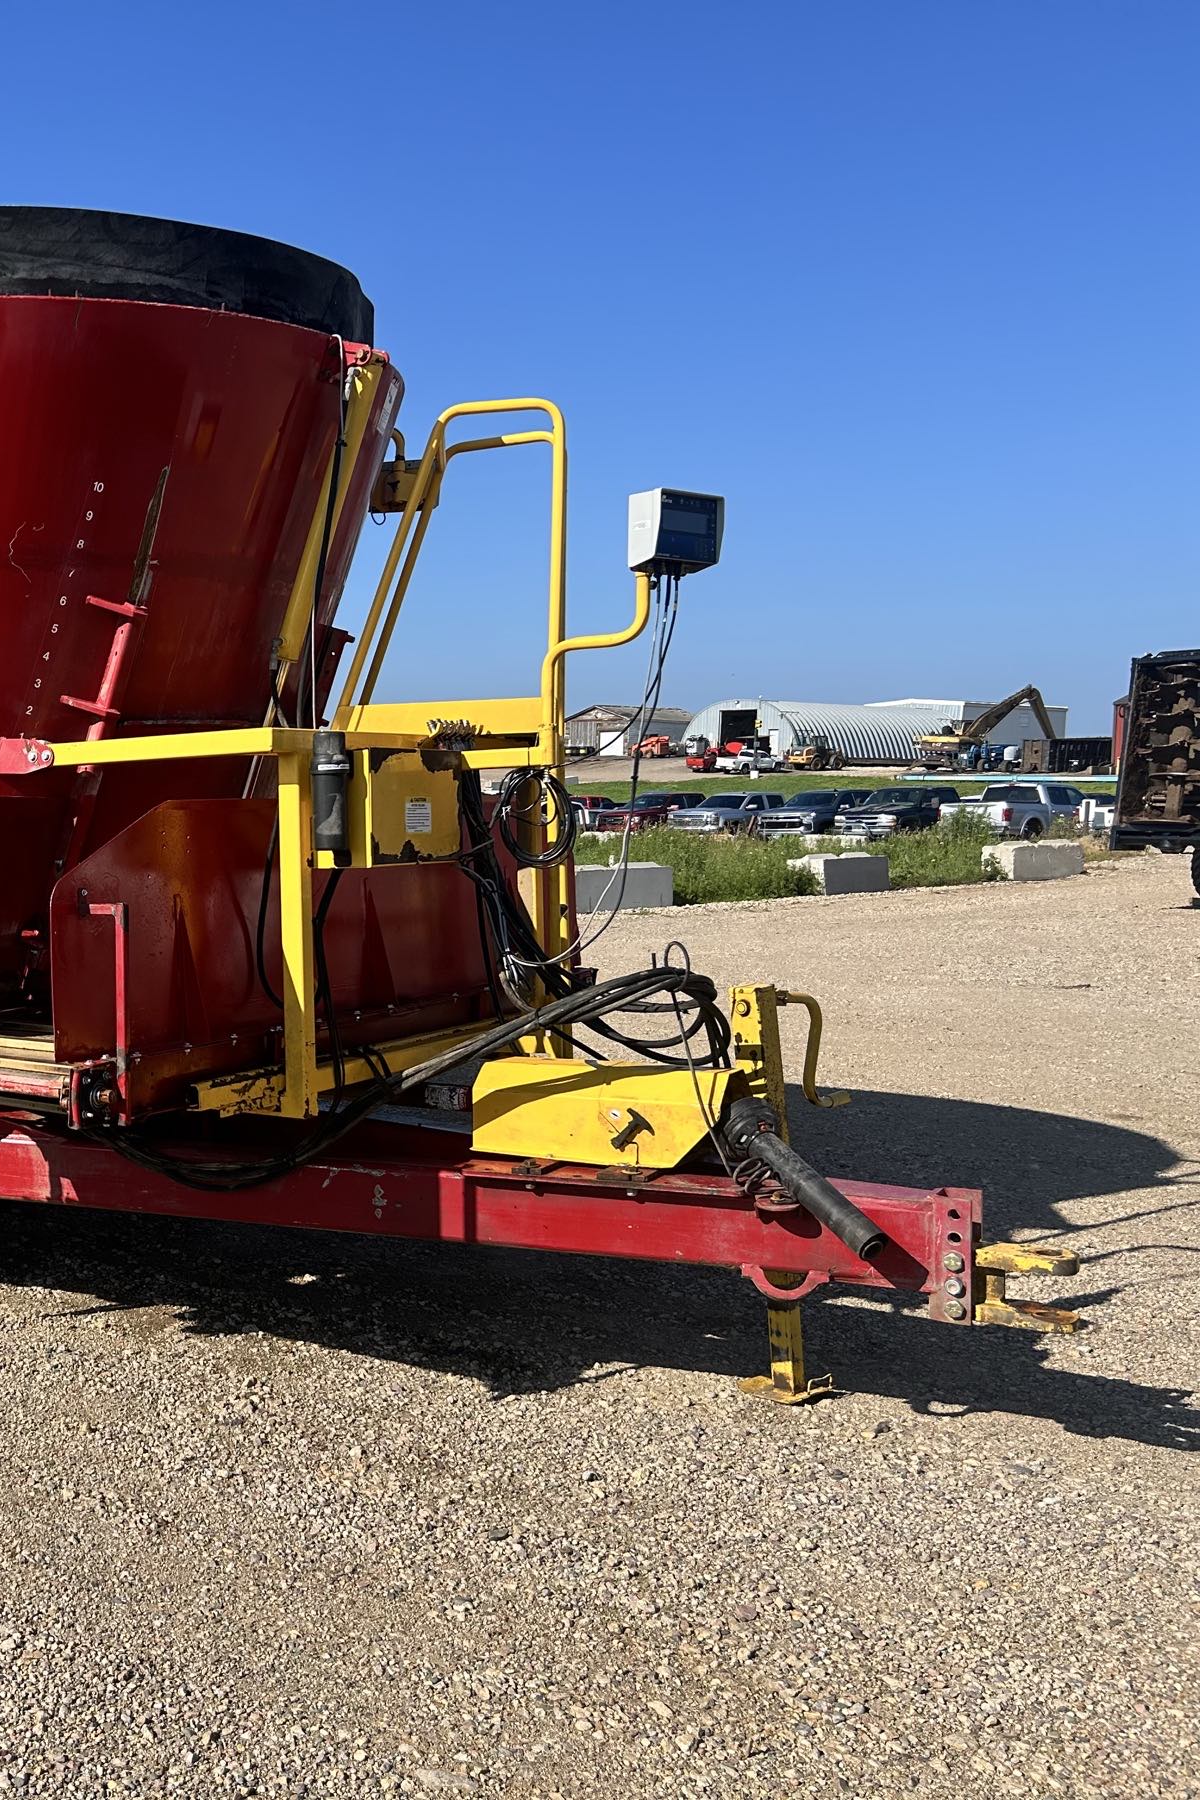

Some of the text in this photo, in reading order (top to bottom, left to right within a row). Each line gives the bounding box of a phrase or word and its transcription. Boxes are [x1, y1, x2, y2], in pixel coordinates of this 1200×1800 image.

[93, 481, 104, 493] 10
[85, 510, 94, 521] 9
[76, 539, 85, 549] 8
[59, 595, 67, 606] 6
[51, 623, 59, 634] 5
[42, 651, 50, 662] 4
[34, 678, 42, 689] 3
[25, 705, 33, 716] 2
